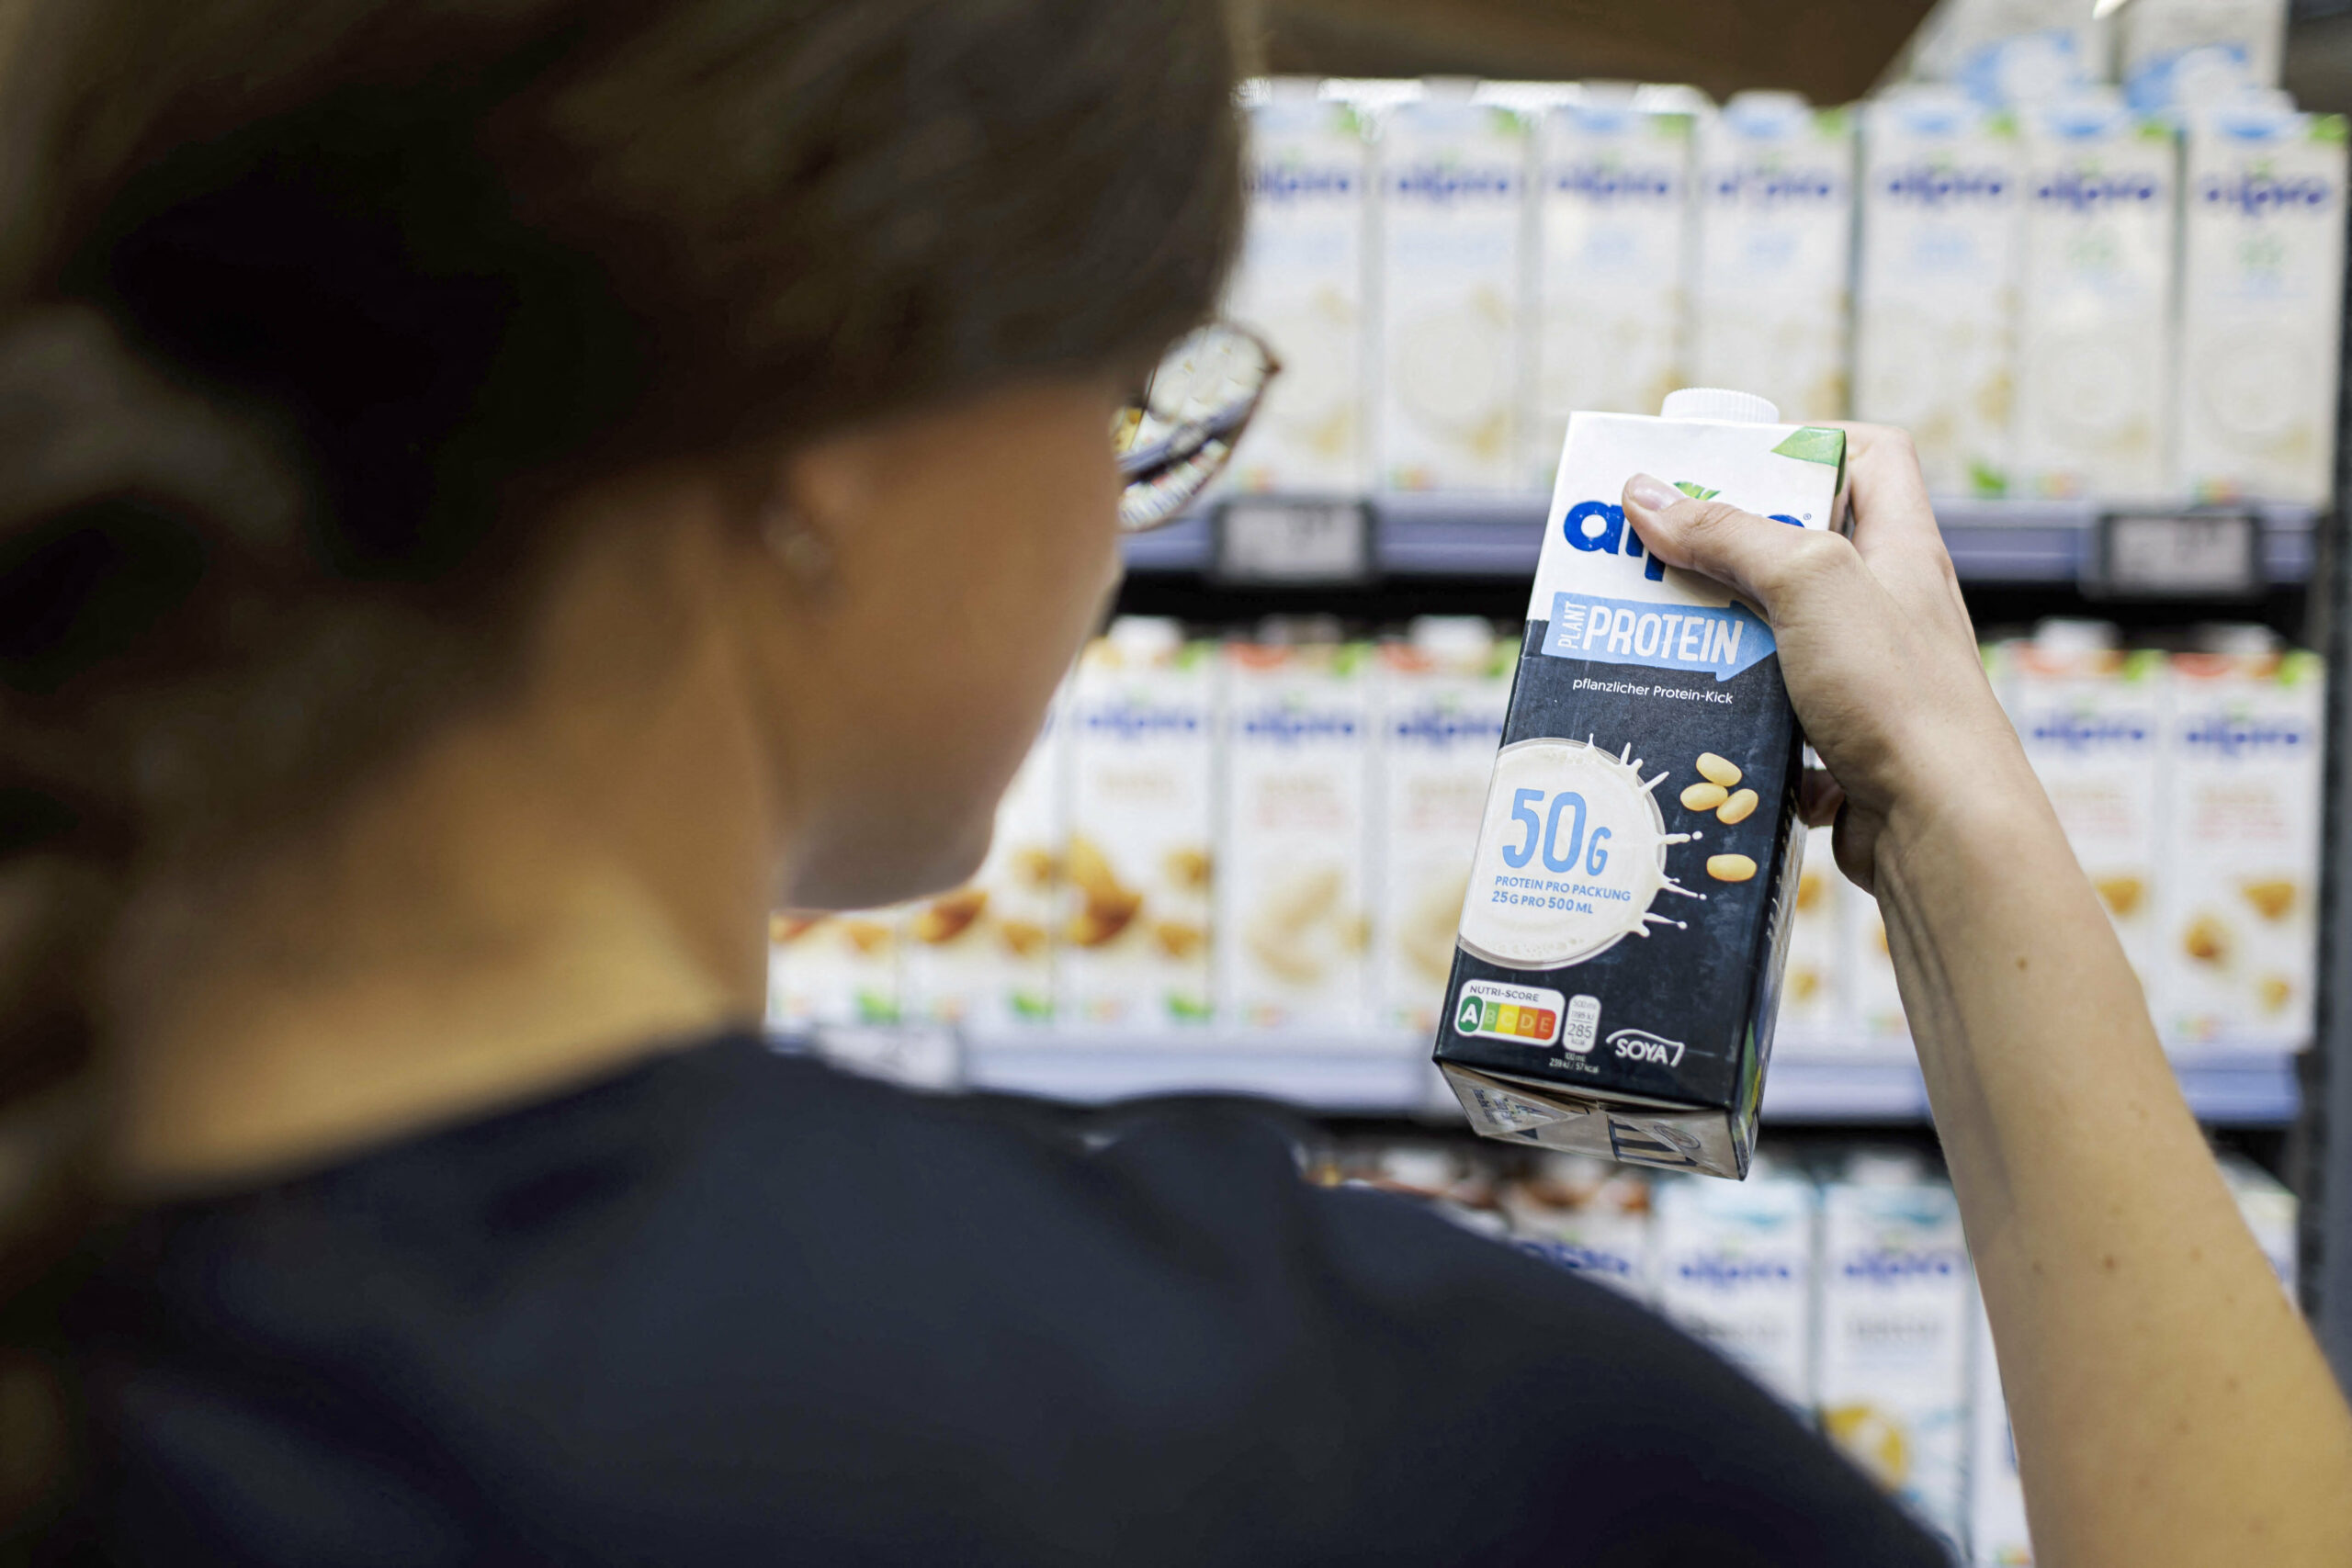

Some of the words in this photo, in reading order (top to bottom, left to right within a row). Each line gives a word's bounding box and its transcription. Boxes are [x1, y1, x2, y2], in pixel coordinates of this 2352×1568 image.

[1558, 601, 1587, 649] PLANT
[1582, 605, 1744, 664] PROTEIN
[1573, 678, 1649, 695] pflanzlicher
[1653, 685, 1734, 704] Protein-Kick
[1502, 788, 1611, 875] 50G
[1495, 875, 1544, 890] PROTEIN
[1545, 881, 1570, 893] PRO
[1572, 884, 1631, 901] PACKUNG
[1521, 895, 1545, 908] PRO
[1469, 984, 1540, 1002] NUTRI-SCORE
[1460, 1003, 1478, 1024] A
[1567, 1023, 1593, 1039] 285
[1614, 1038, 1668, 1066] SOYA
